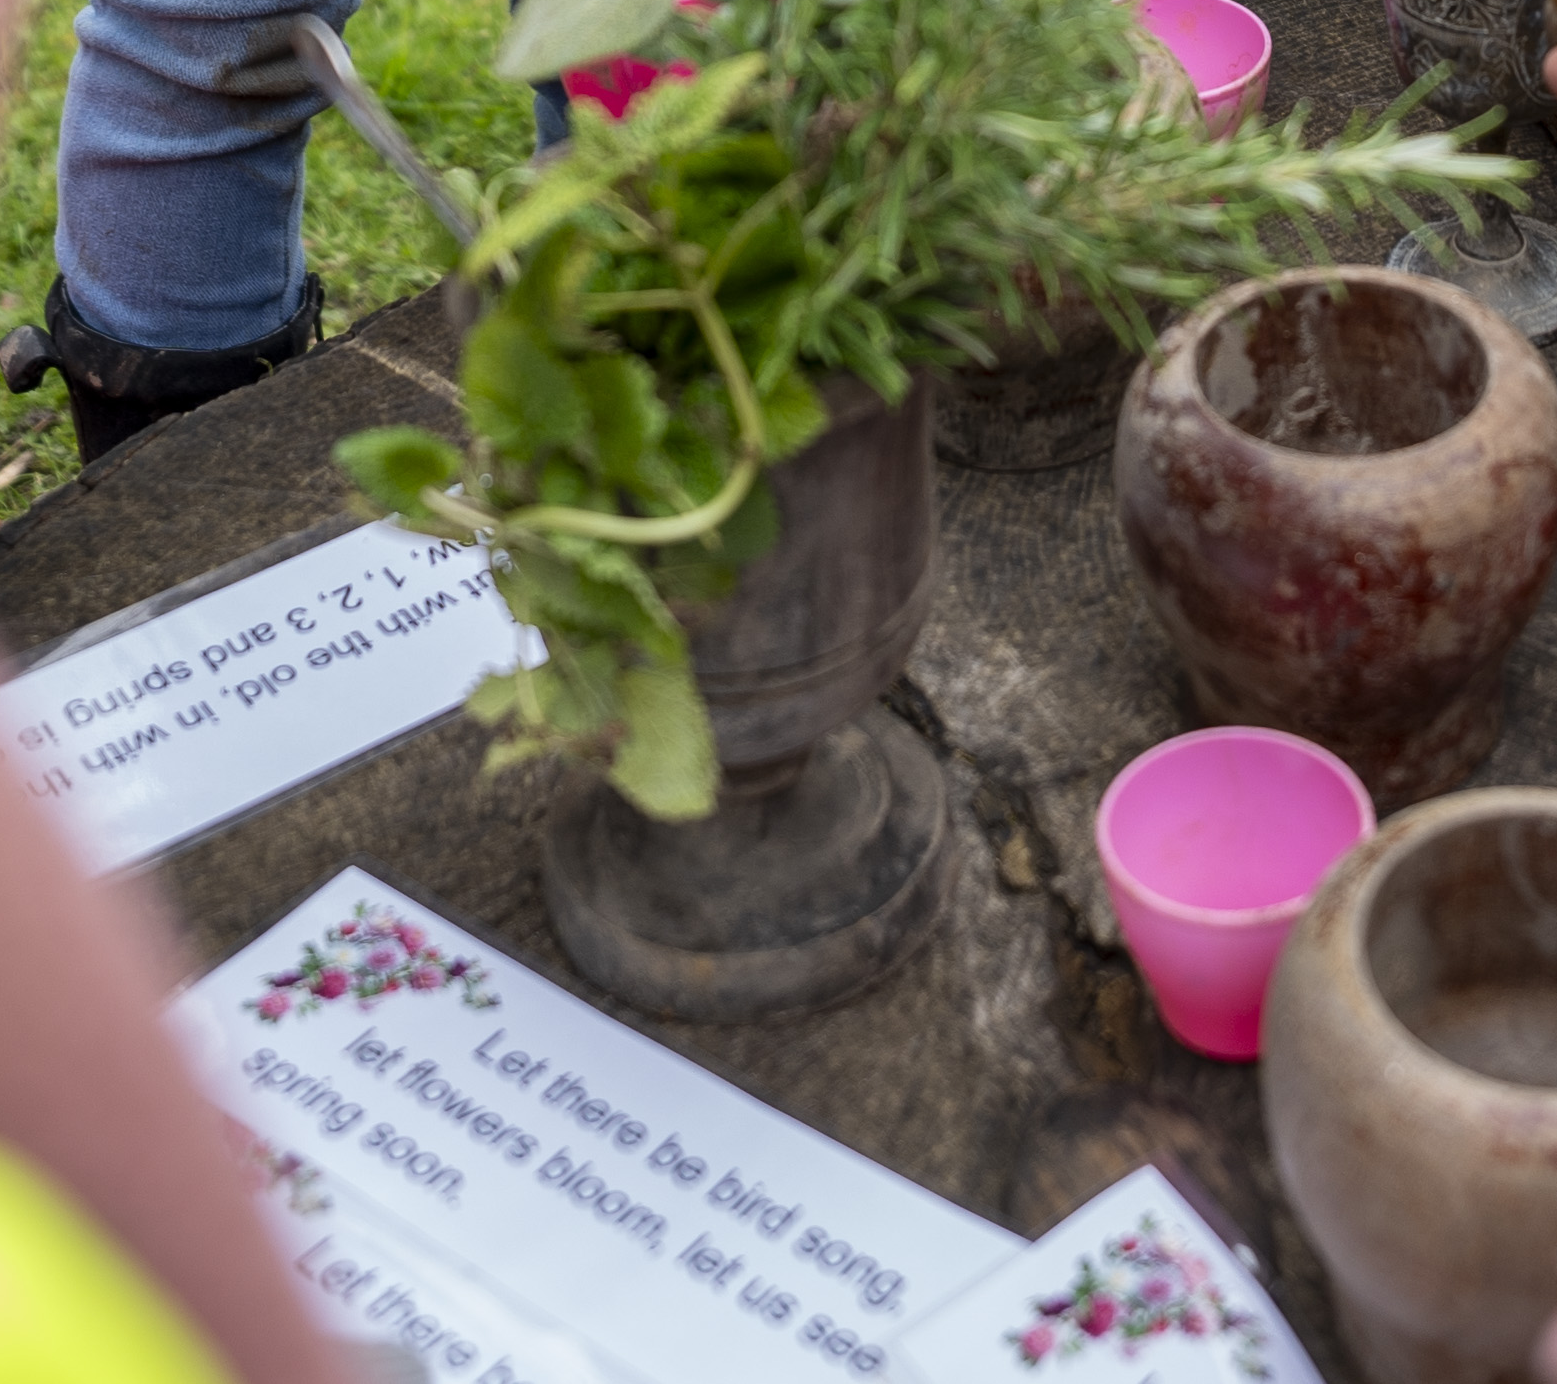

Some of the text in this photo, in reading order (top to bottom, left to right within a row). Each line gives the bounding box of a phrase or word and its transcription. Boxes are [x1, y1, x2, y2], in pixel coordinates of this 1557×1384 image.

[286, 606, 317, 633] 3
[376, 591, 459, 635] with
[200, 622, 277, 673] and
[305, 630, 374, 668] the
[63, 660, 193, 727] spring
[220, 664, 298, 707] old,
[175, 701, 220, 729] in
[80, 723, 171, 772] with
[243, 1047, 365, 1137] spring
[472, 1028, 550, 1088] Let
[541, 1072, 649, 1150] there
[645, 1132, 708, 1187] be
[705, 1167, 803, 1238] bird
[342, 1025, 885, 1375] let flowers bloom, let us see
[292, 1234, 378, 1297] Let
[366, 1282, 479, 1370] there
